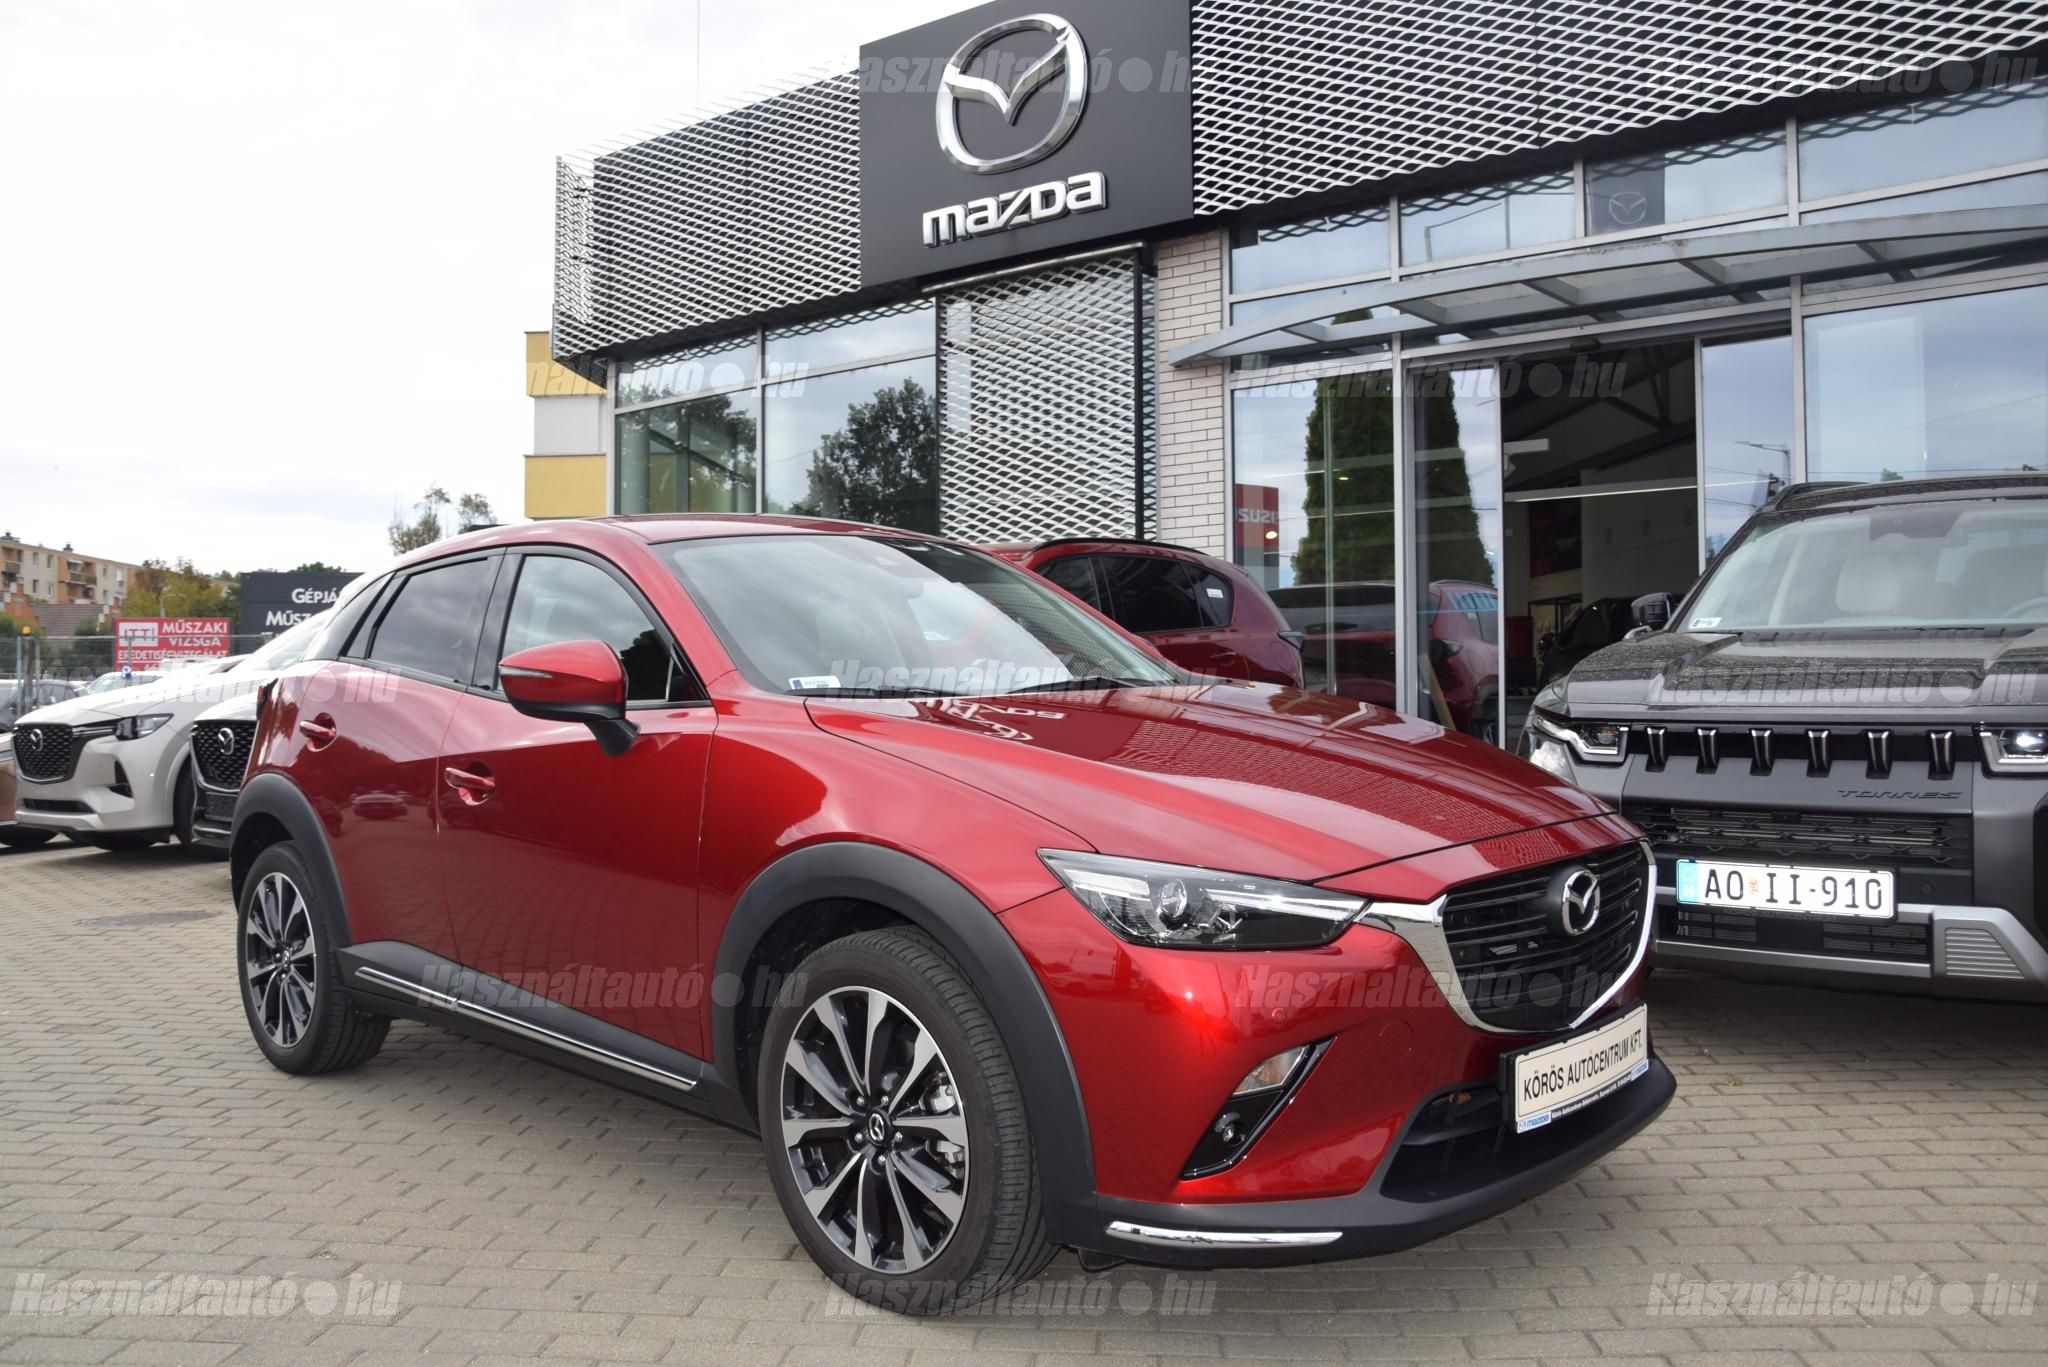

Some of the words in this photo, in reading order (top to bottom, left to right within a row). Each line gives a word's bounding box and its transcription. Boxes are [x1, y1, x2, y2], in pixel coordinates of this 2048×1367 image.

[922, 171, 1108, 248] mazda
[291, 587, 341, 604] GÉPJÁ
[162, 619, 228, 634] MŰSZAKI
[168, 635, 222, 648] VIZSGA
[1838, 790, 1963, 799] TORRES
